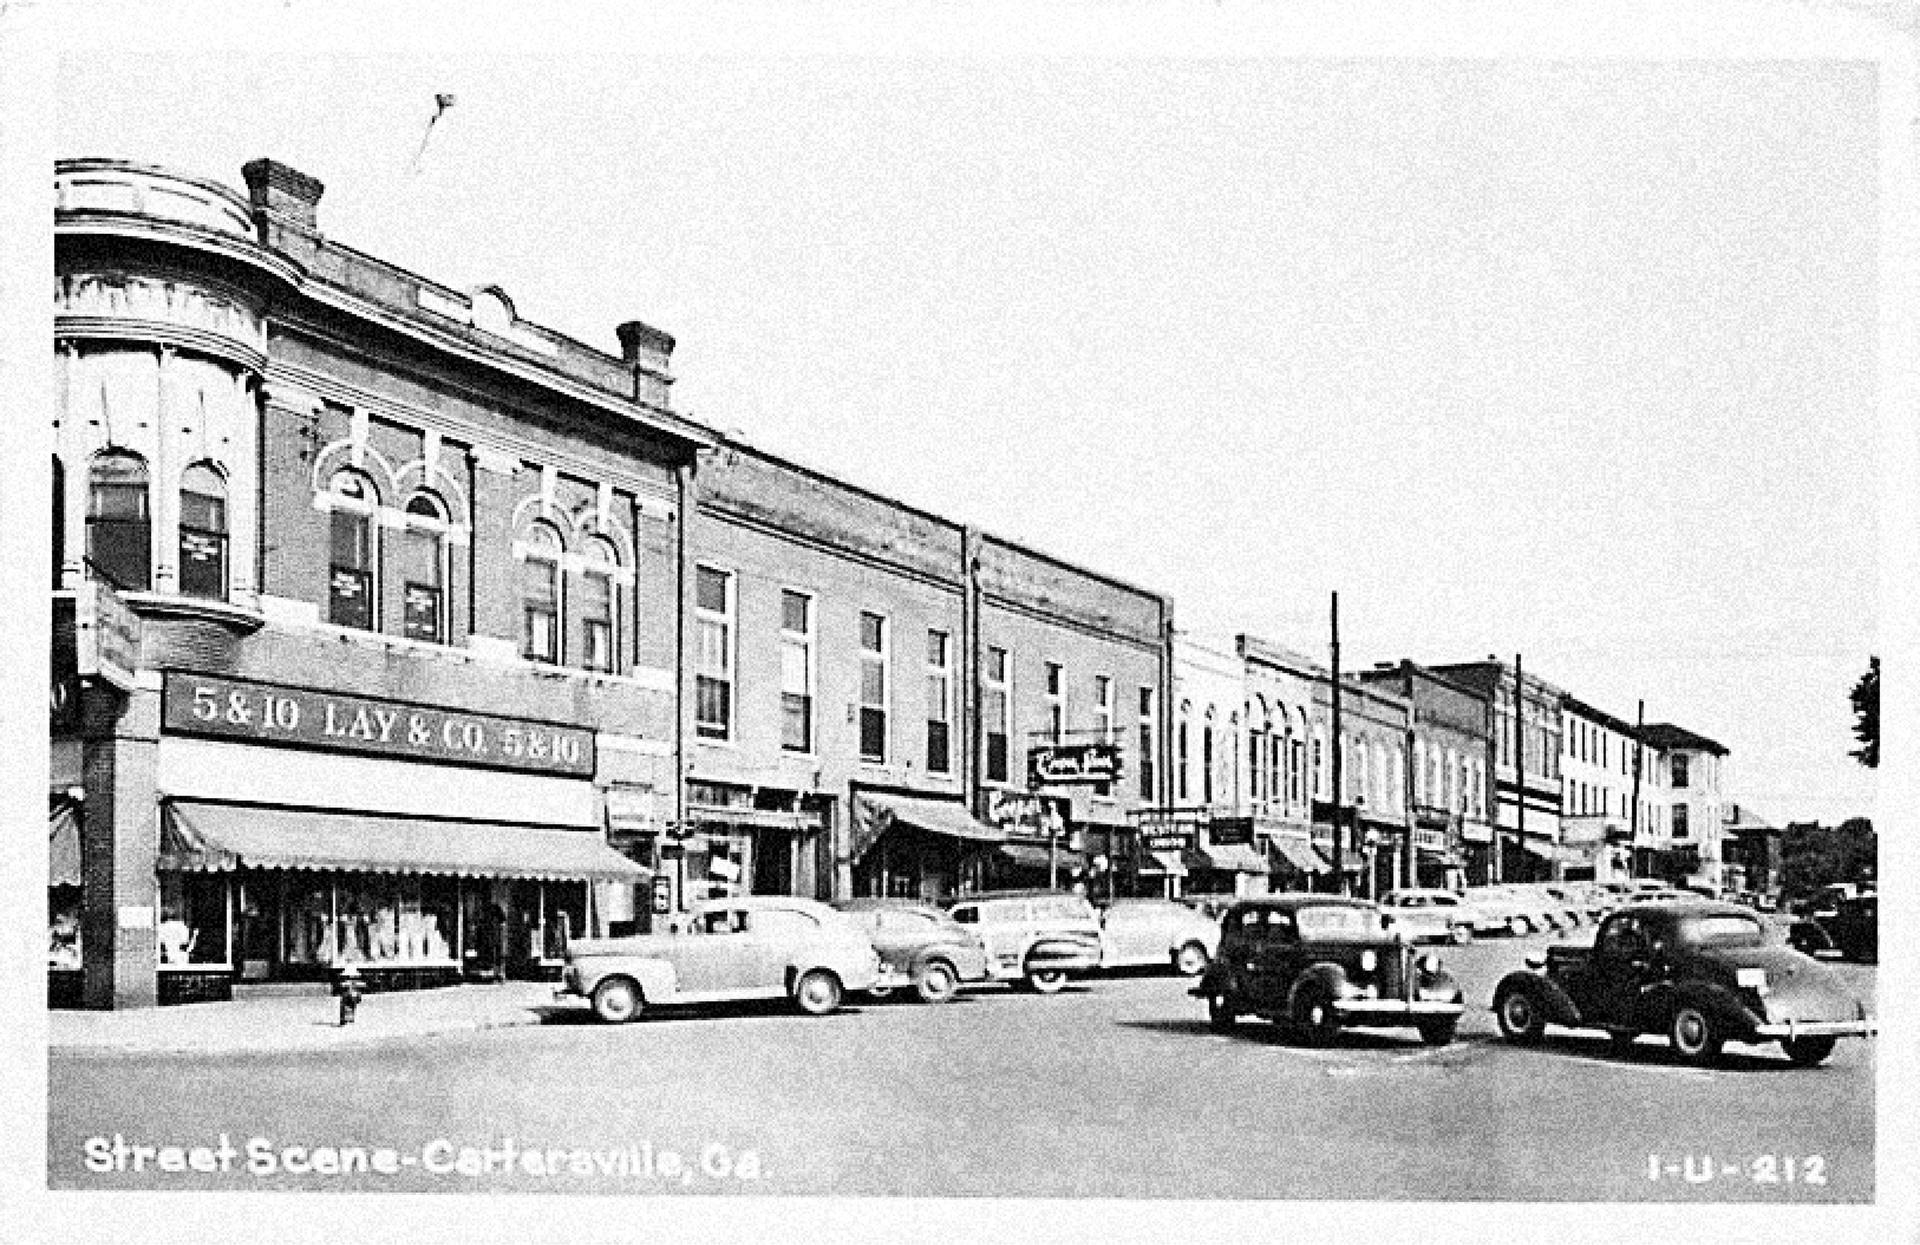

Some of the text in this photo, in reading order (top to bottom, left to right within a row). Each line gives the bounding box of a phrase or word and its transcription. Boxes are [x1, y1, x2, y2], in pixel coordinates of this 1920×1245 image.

[193, 687, 217, 721] 5
[263, 696, 300, 730] 10
[324, 703, 398, 742] LAY
[407, 715, 431, 745] &
